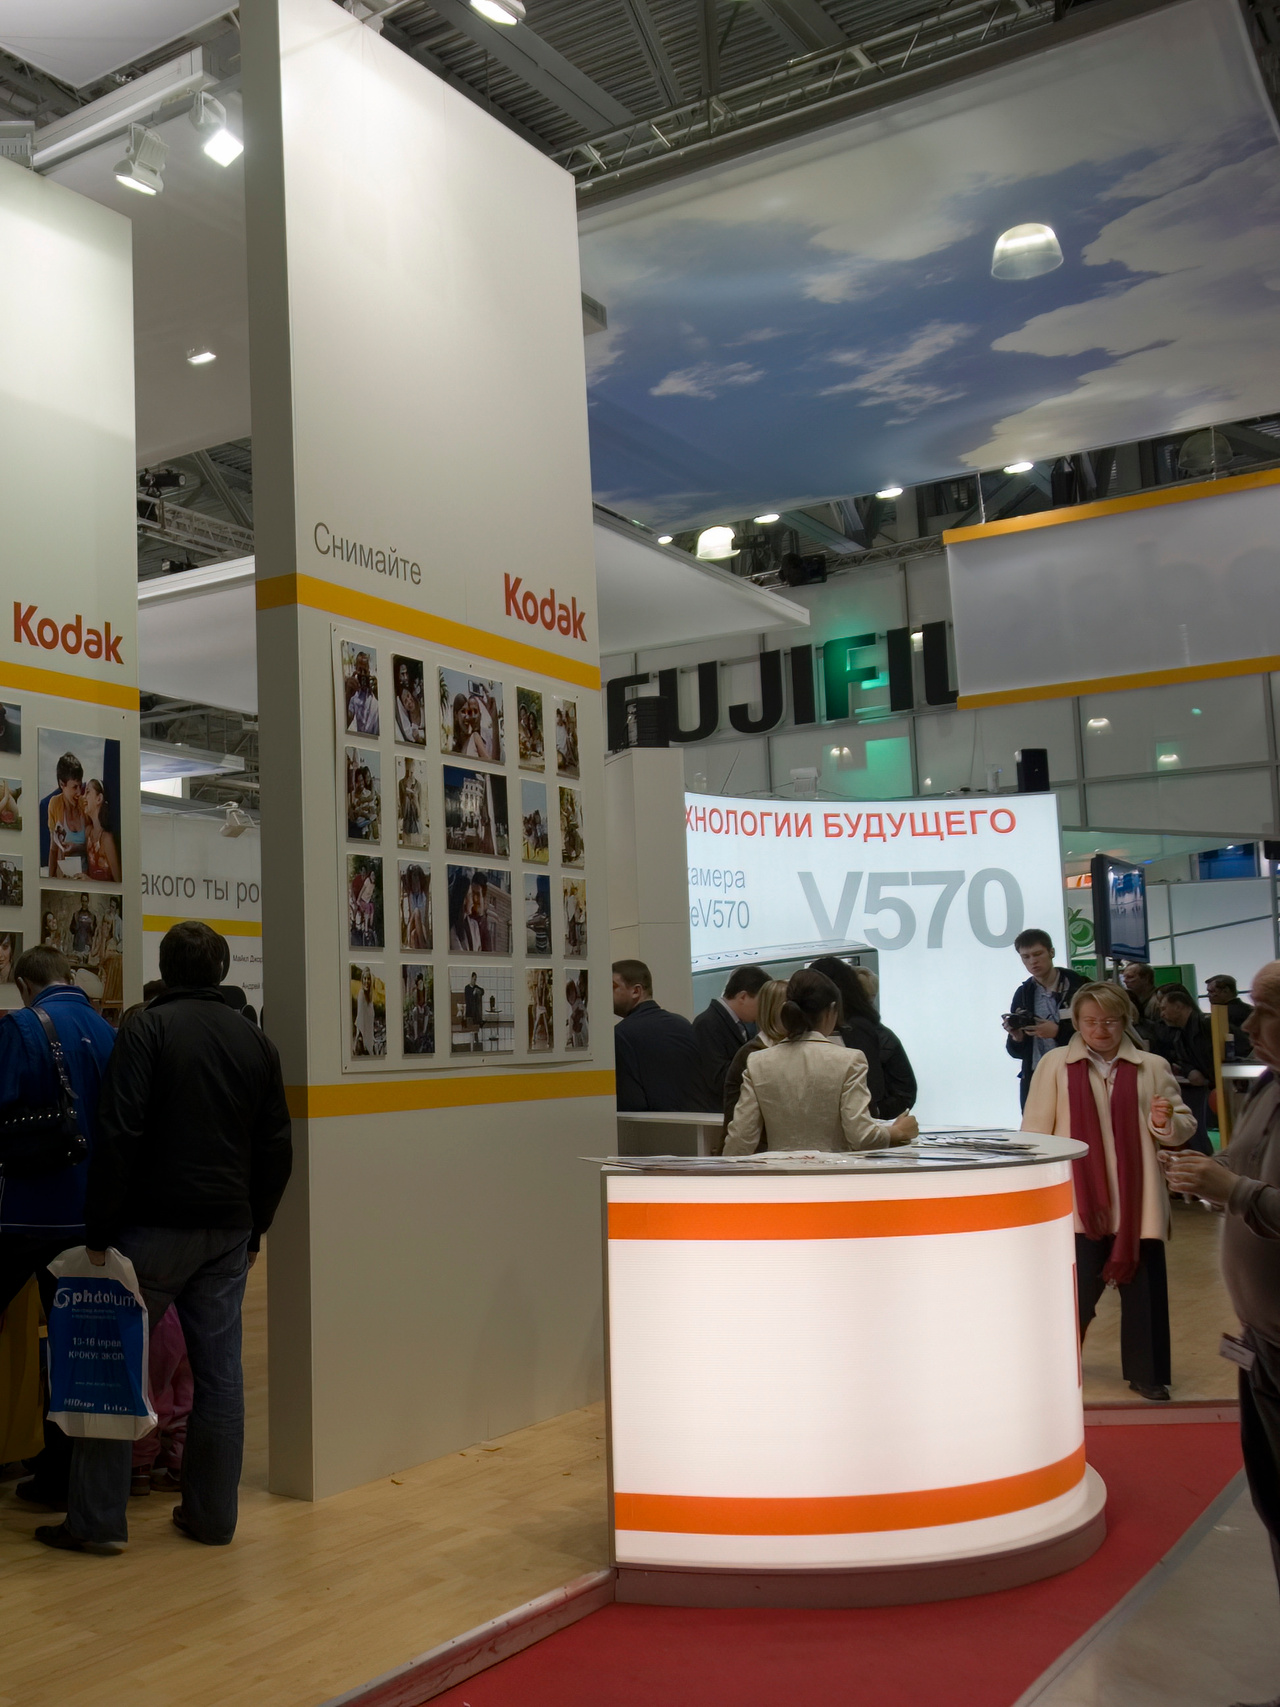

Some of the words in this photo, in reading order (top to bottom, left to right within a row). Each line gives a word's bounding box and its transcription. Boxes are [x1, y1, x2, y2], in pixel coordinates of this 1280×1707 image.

[314, 522, 422, 585] Снимайте
[503, 572, 588, 642] Kodak
[13, 601, 124, 664] Kodak
[823, 808, 1017, 842] БУДУЩЕГО
[202, 879, 228, 900] ты
[688, 864, 746, 893] амера
[690, 900, 750, 929] eV570
[797, 867, 1025, 951] V570
